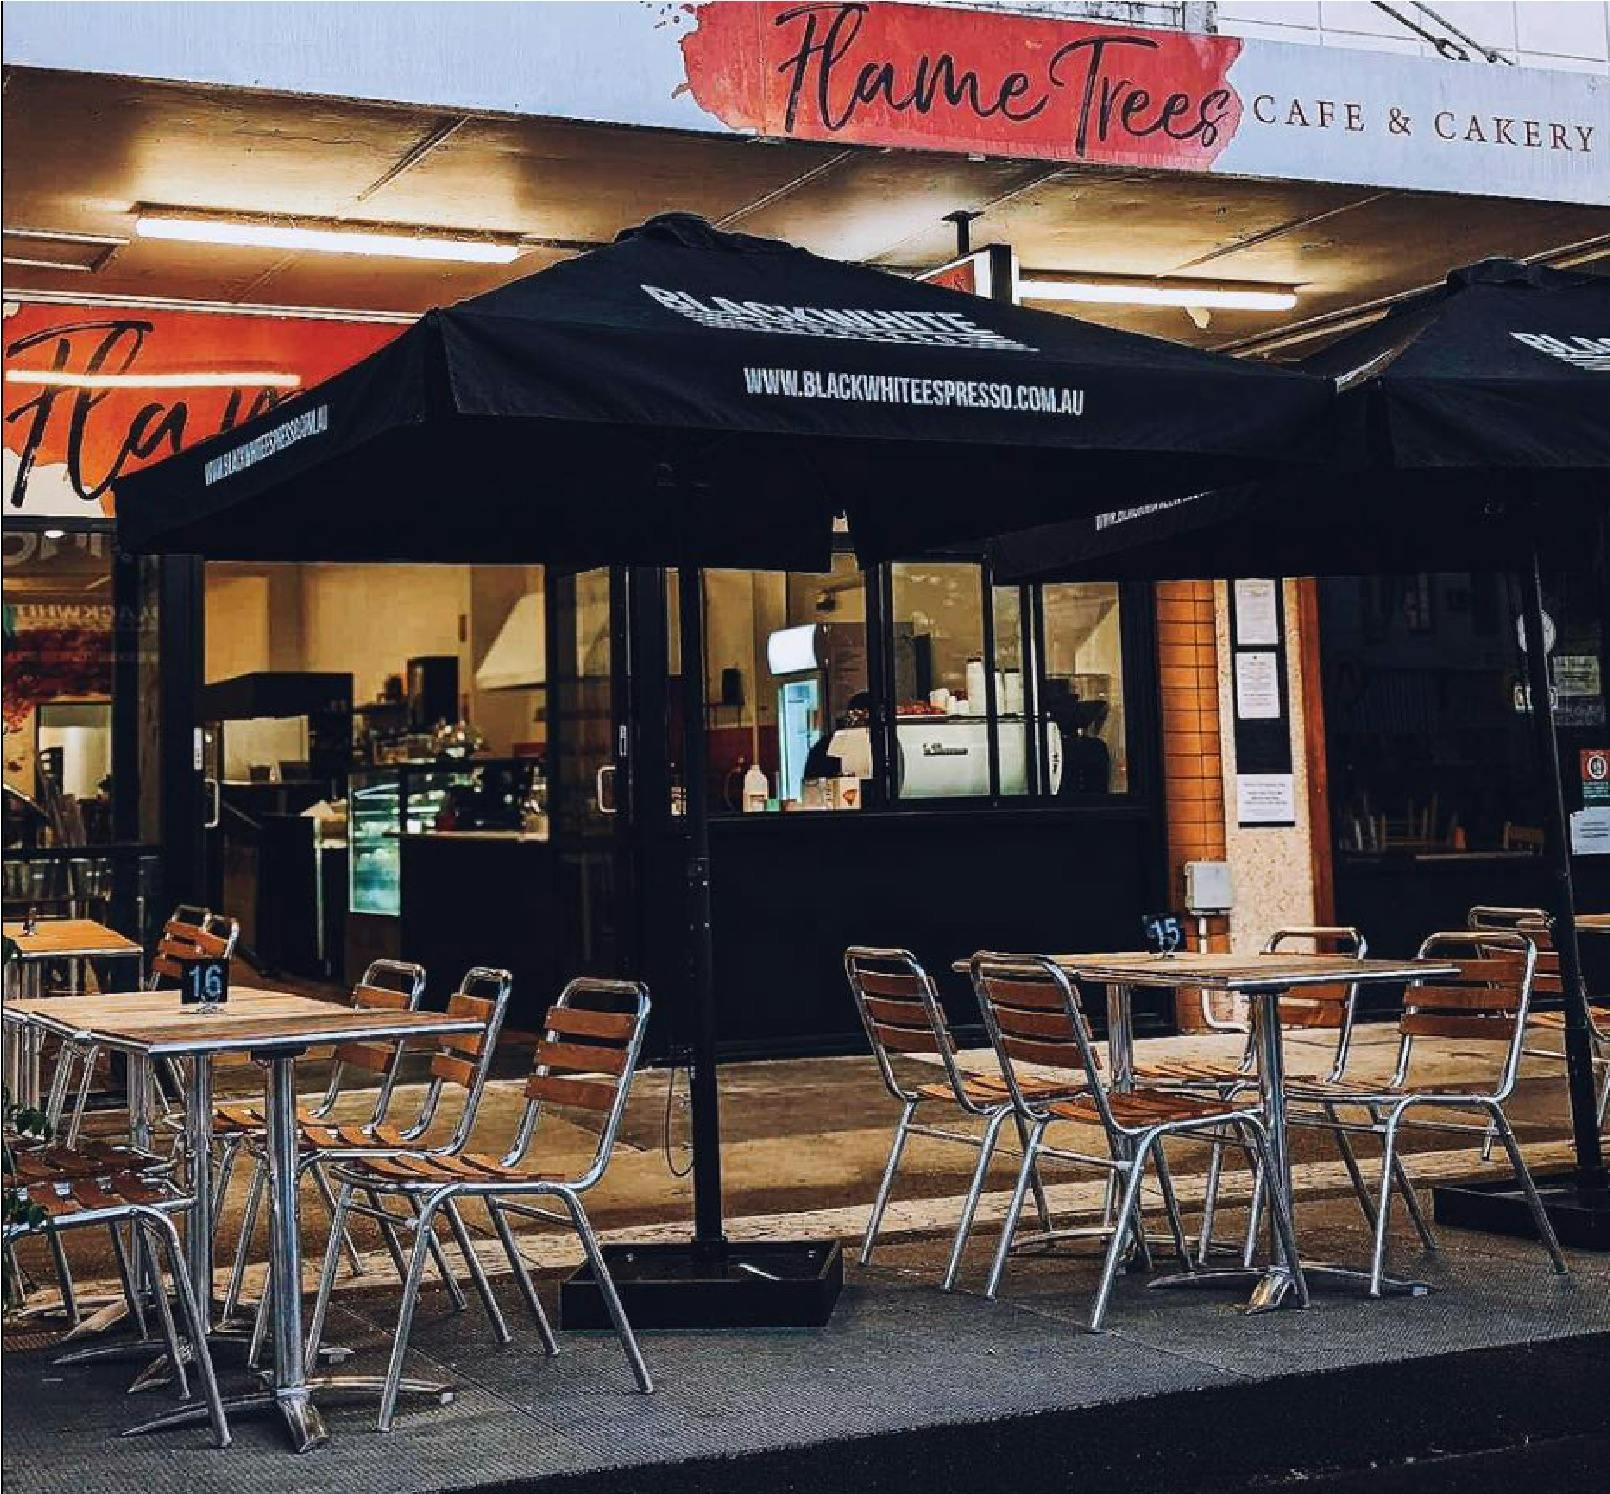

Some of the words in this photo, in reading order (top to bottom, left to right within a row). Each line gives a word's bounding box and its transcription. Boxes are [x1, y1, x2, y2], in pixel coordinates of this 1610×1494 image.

[776, 3, 1049, 133] Flame
[1049, 34, 1232, 158] Trees
[1253, 94, 1366, 132] CAFE
[1388, 106, 1412, 136] &
[1434, 111, 1595, 153] CAKERY
[640, 284, 993, 334] BLACKWHITE
[743, 367, 1085, 416] WWW.BLACKWHITEESPRESSO.COM.AU
[1150, 917, 1179, 946] 15
[188, 964, 222, 997] 16
